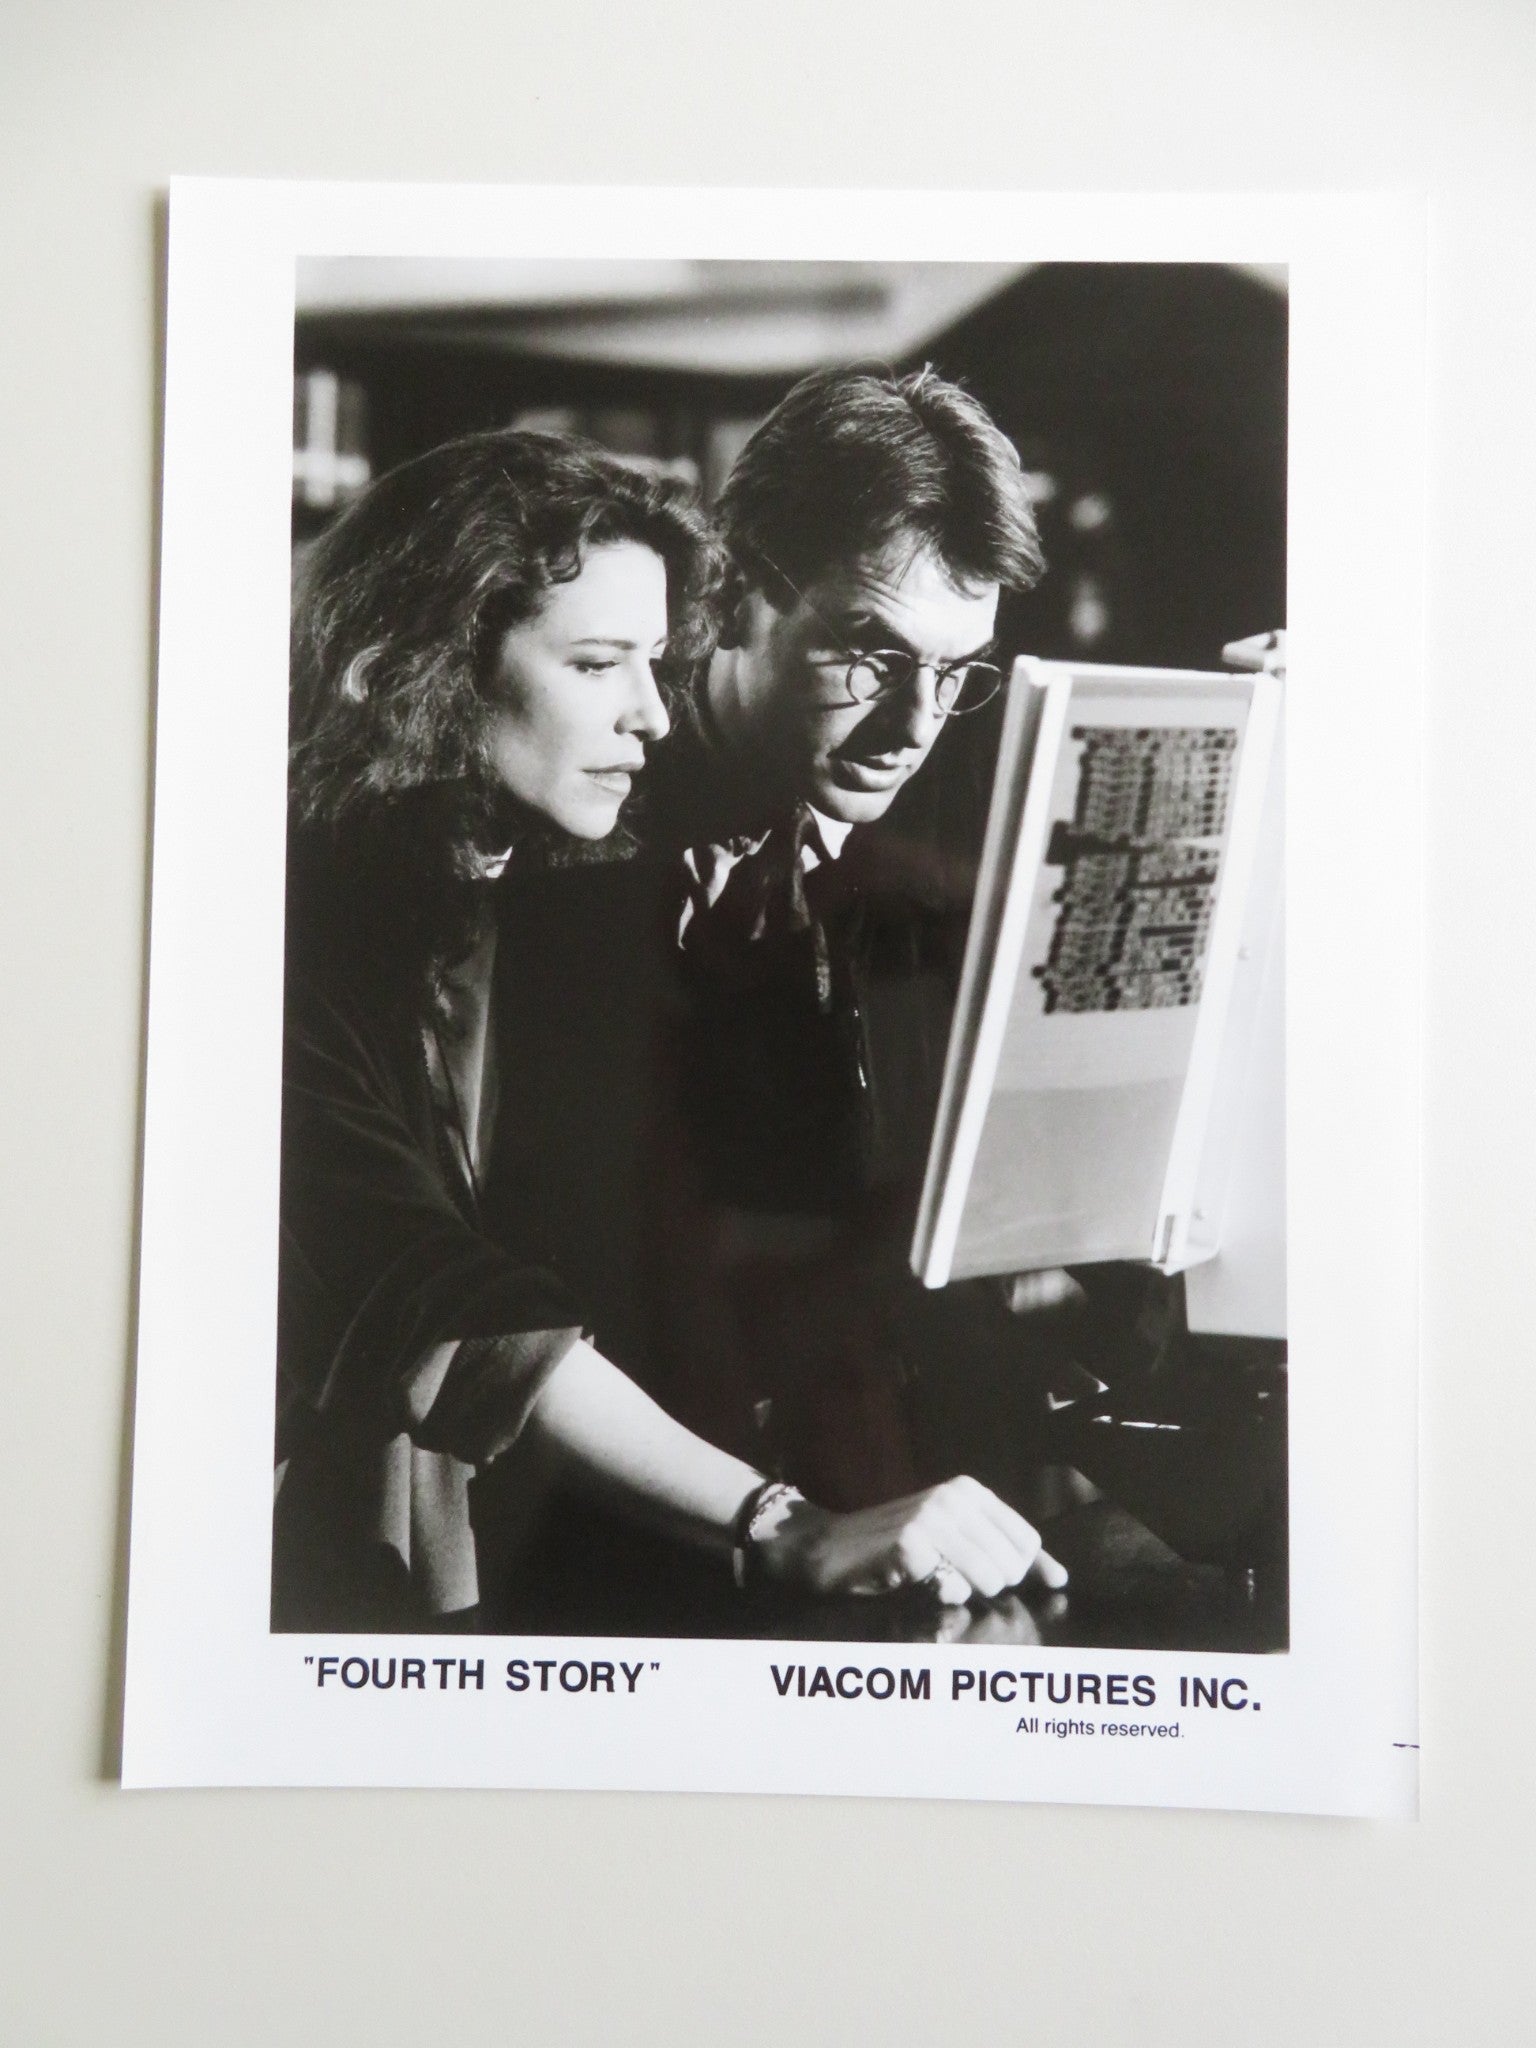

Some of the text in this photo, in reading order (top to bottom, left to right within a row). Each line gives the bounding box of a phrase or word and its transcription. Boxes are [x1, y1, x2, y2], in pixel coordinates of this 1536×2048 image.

[304, 1656, 660, 1693] "FOURTH STORY"
[770, 1664, 1261, 1711] VIACOM PICTURES INC.
[1016, 1717, 1185, 1739] All rights reserved.
